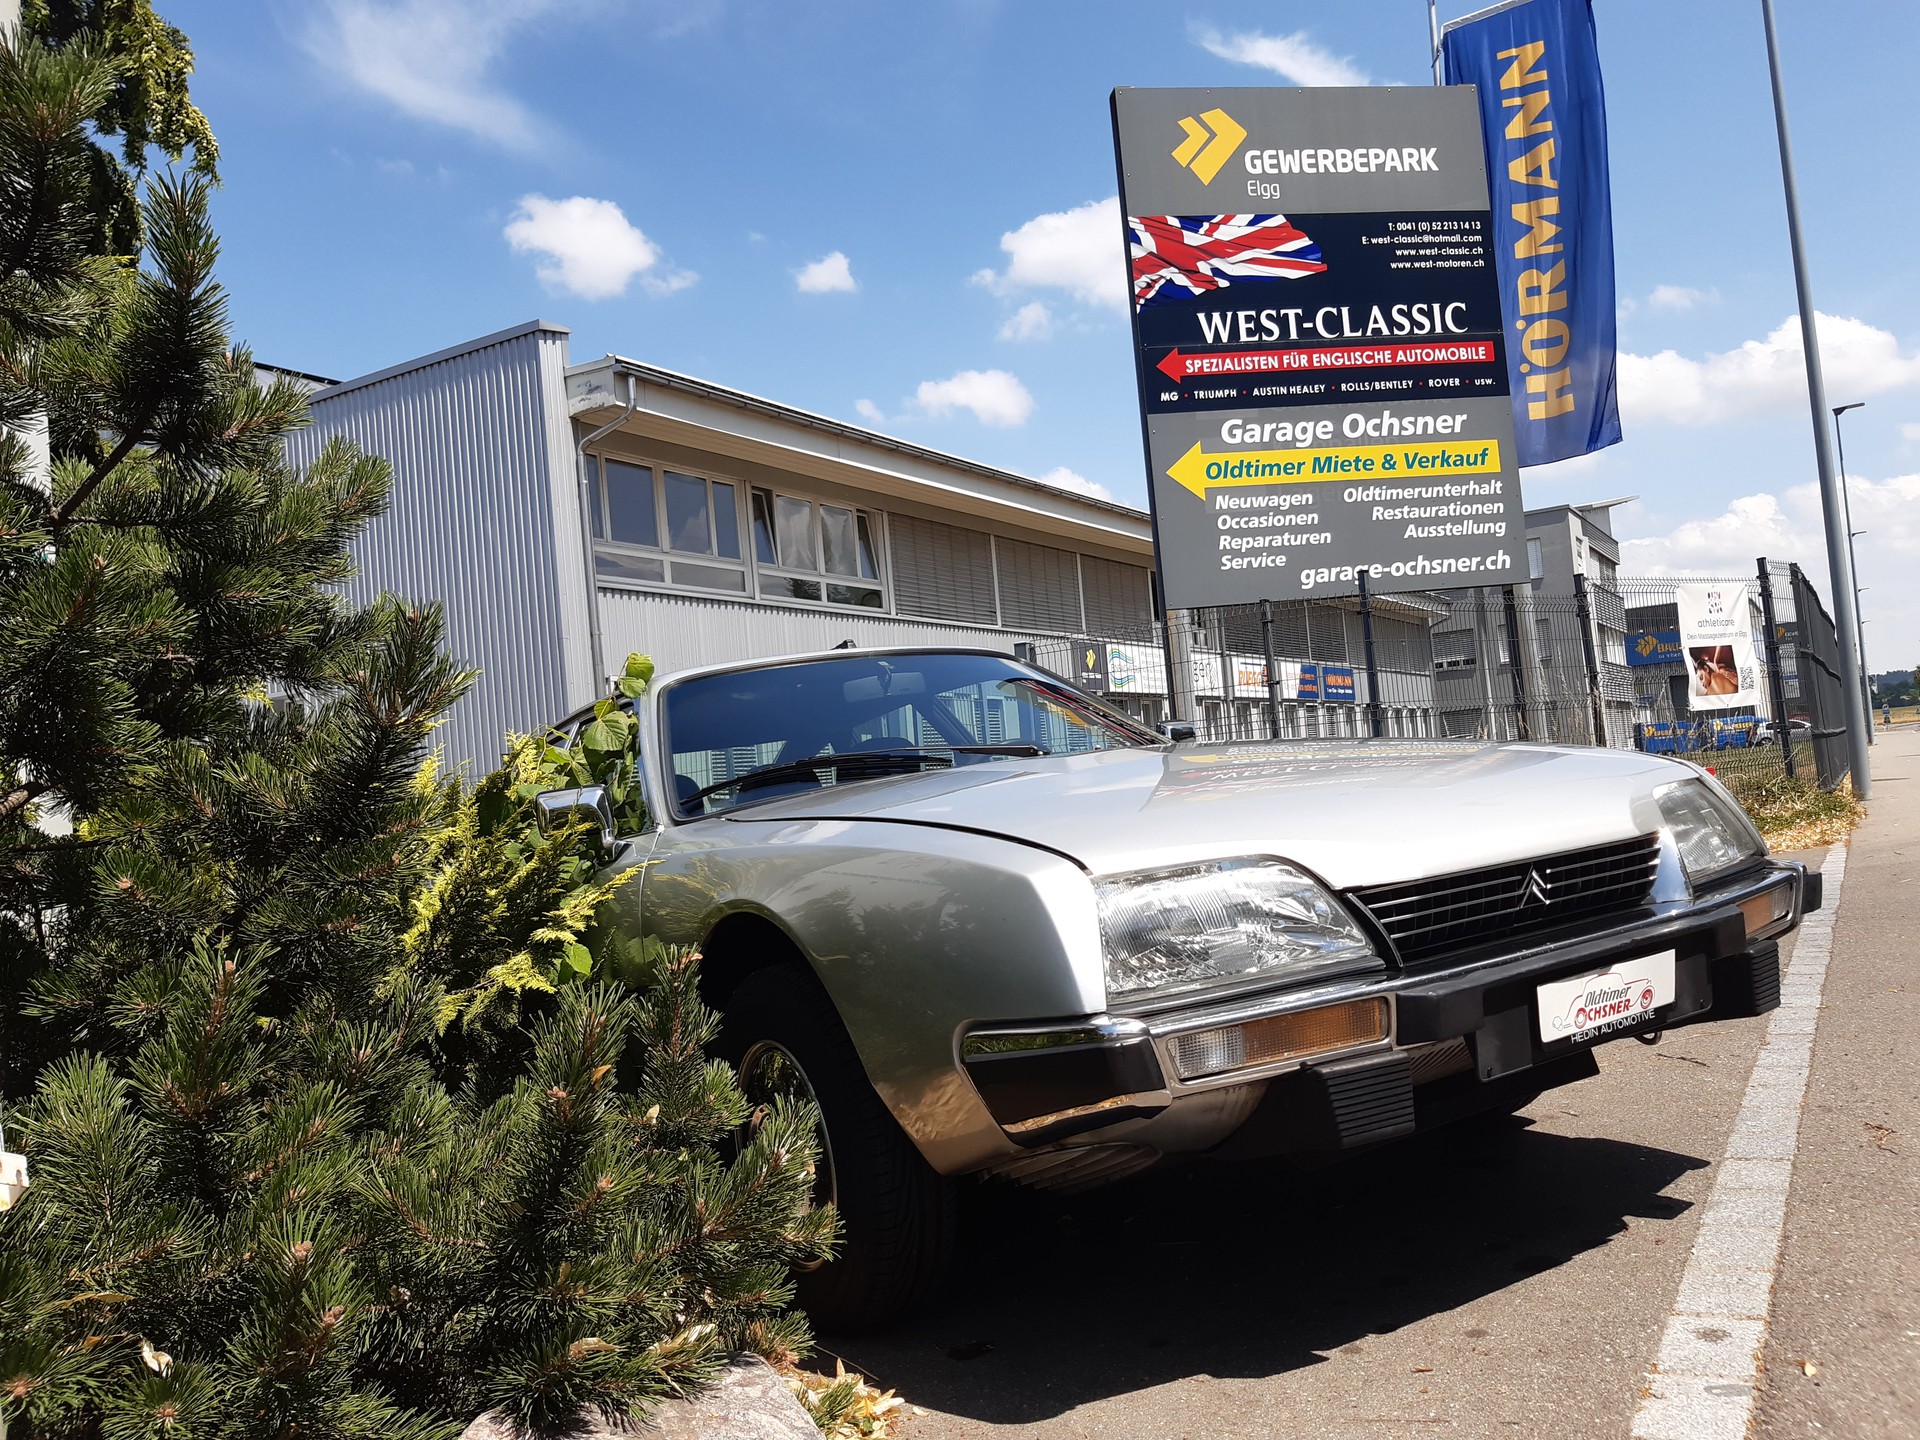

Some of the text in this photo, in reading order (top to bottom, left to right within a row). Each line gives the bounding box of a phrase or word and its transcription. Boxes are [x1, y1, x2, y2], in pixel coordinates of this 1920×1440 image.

[1245, 148, 1439, 174] GEWERBEPARK
[1247, 180, 1280, 199] Elgg
[1388, 221, 1481, 233] T: 0041 (0) 52 213 14 13
[1496, 39, 1575, 420] HÖRMANN
[1361, 233, 1482, 245] E: west-classic@hotmail.com
[1395, 246, 1484, 256] www.west-classic.ch
[1390, 258, 1485, 269] www.west-motoren.ch
[1197, 303, 1467, 343] WEST-CLASSIC
[1185, 346, 1487, 374] SPEZIALISTEN FÜR ENGLISCHE AUTOMOBILE
[1160, 377, 1496, 402] MG TRIUMPH AUSTIN HEALEY ROLLS/BENTLEY ROVER usw.
[1221, 419, 1333, 447] Garage
[1343, 410, 1467, 438] Ochsner
[1205, 448, 1488, 480] Oldtimer Miete & Verkauf
[1215, 492, 1313, 511] Neuwagen
[1343, 479, 1503, 503] Oldtimerunterhalt
[1218, 512, 1318, 529] Occasionen
[1371, 501, 1504, 521] Restaurationen
[1403, 519, 1507, 539] Ausstellung
[1219, 530, 1332, 552] Reparaturen
[1221, 550, 1286, 570] Service
[1697, 617, 1735, 628] athleticare
[1584, 986, 1631, 1008] Oldtimer
[1574, 998, 1631, 1029] OCHSNER
[1570, 1008, 1655, 1044] HEDIN AUTOMOTIVE
